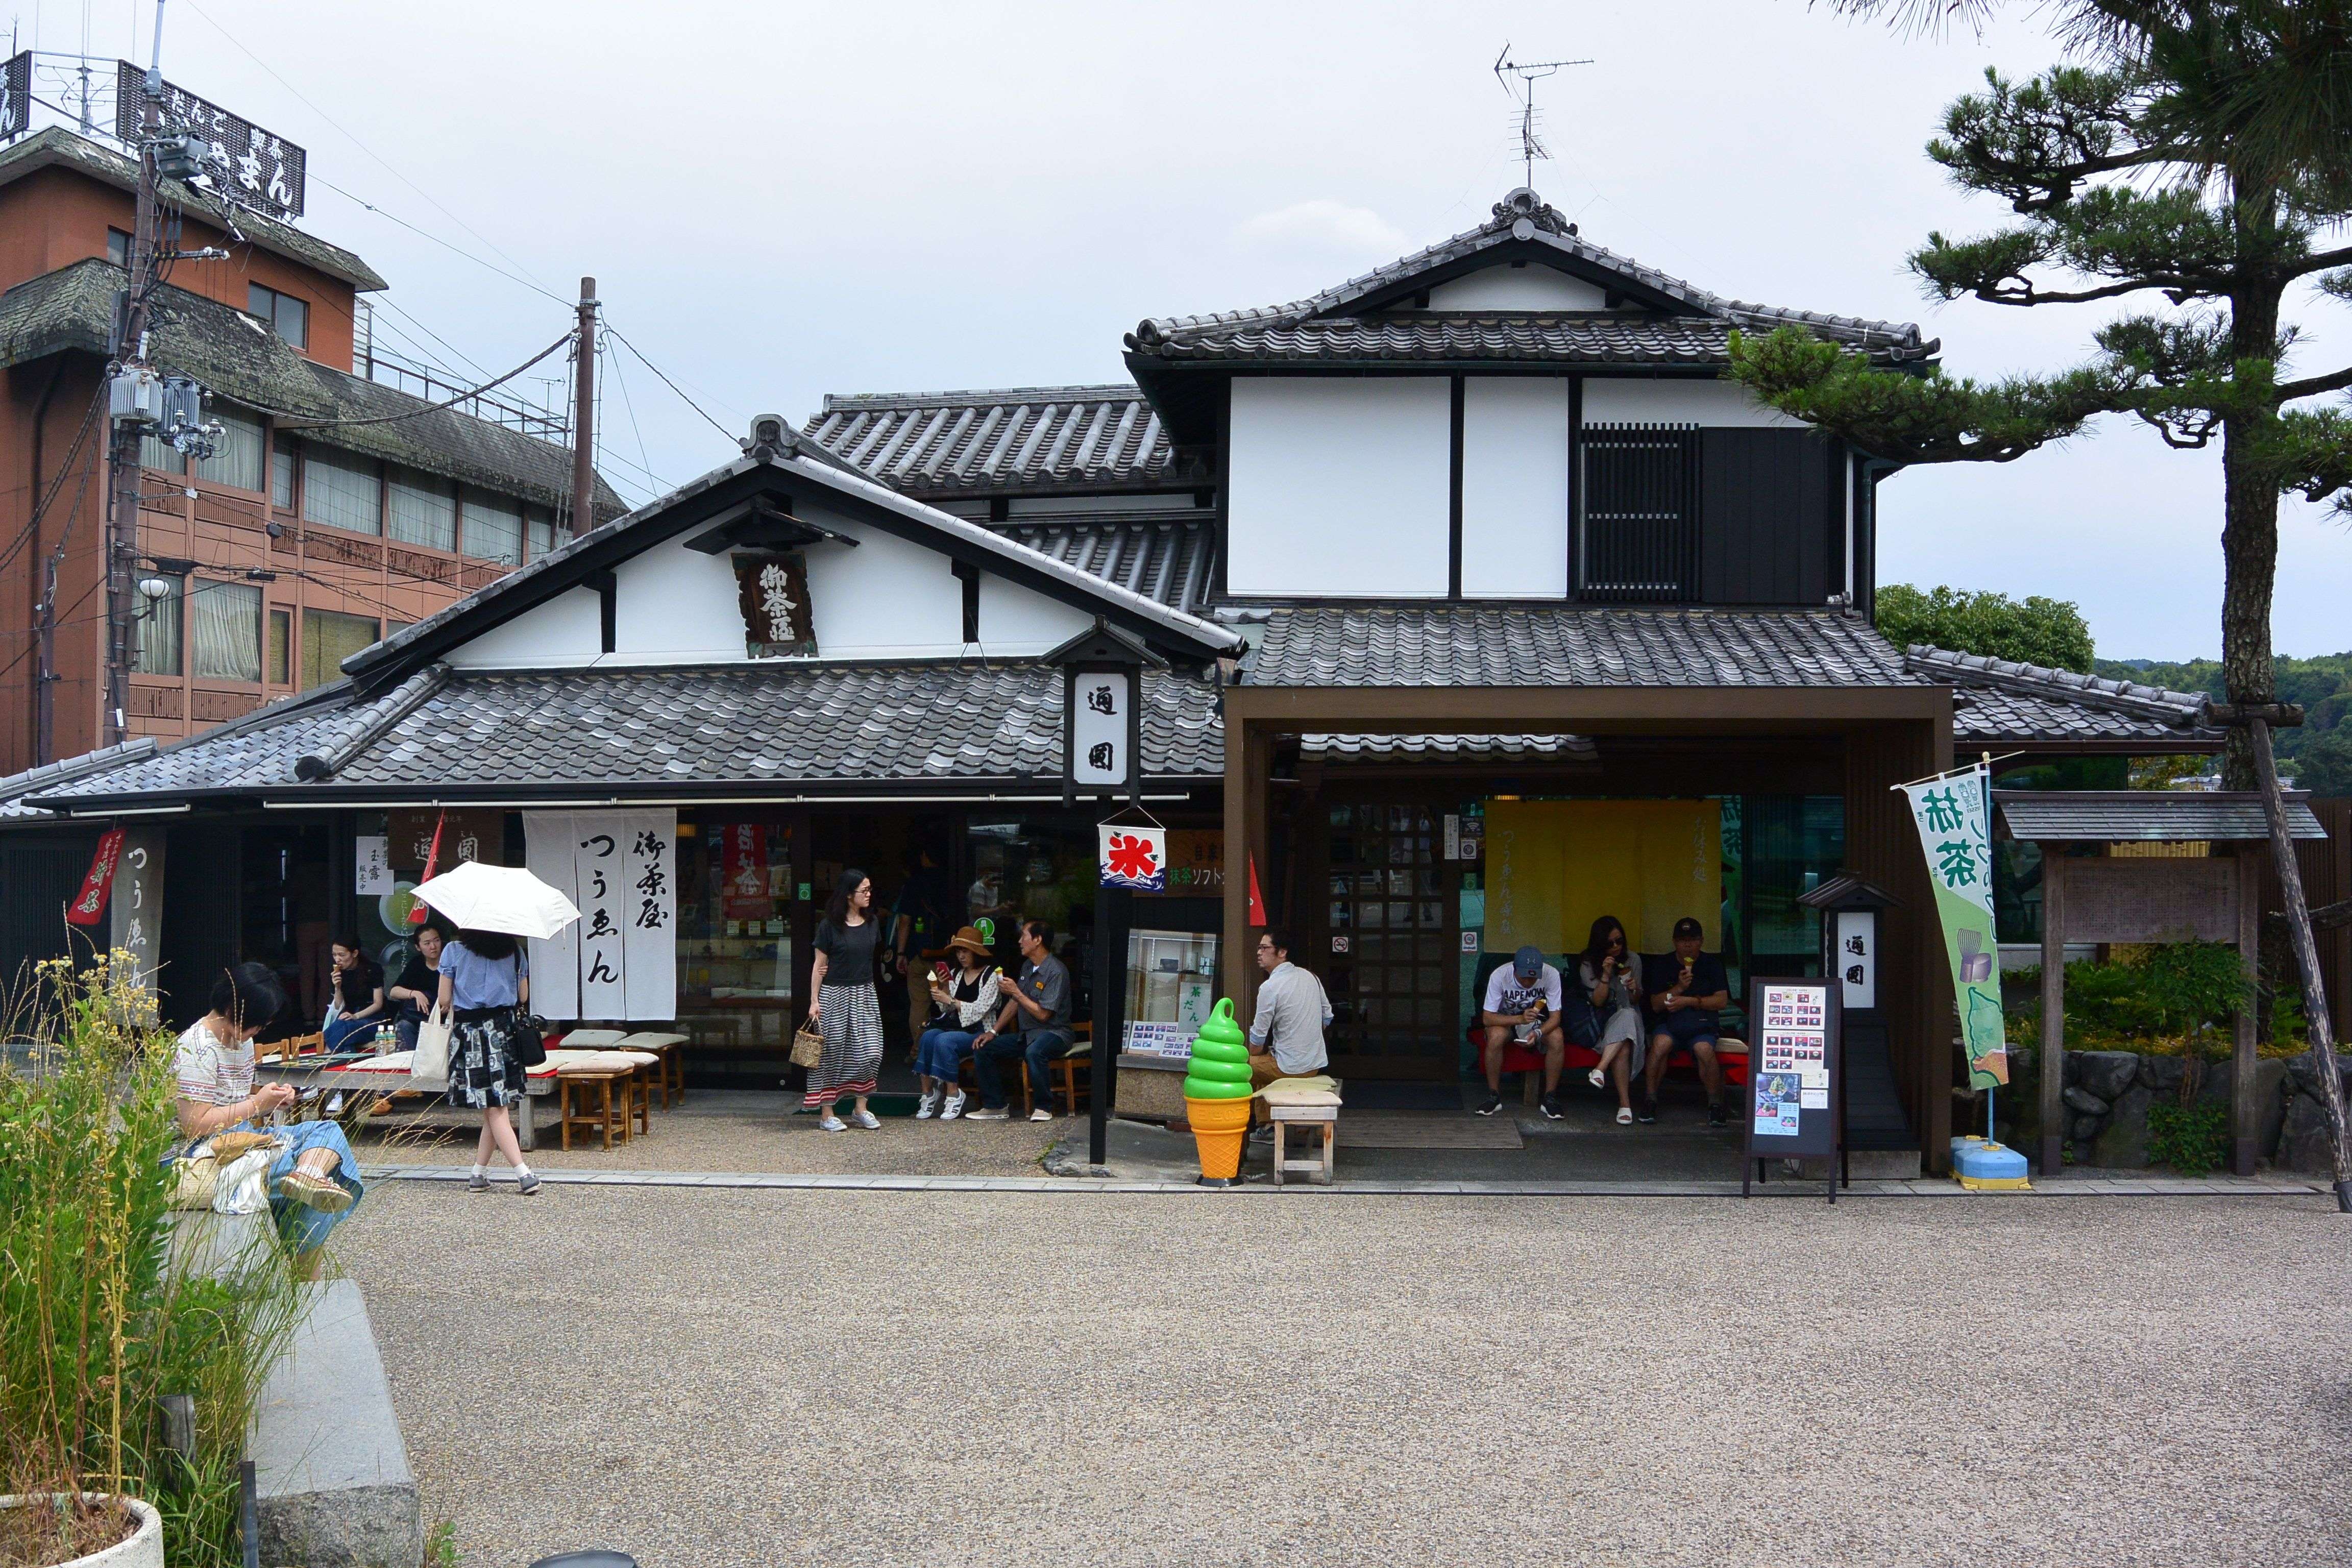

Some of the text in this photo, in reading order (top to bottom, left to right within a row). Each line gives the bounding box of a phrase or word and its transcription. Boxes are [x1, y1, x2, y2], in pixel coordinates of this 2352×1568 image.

[369, 849, 381, 881] 玉露
[1108, 835, 1157, 879] 氷
[1169, 866, 1224, 886] 抹茶ソフト
